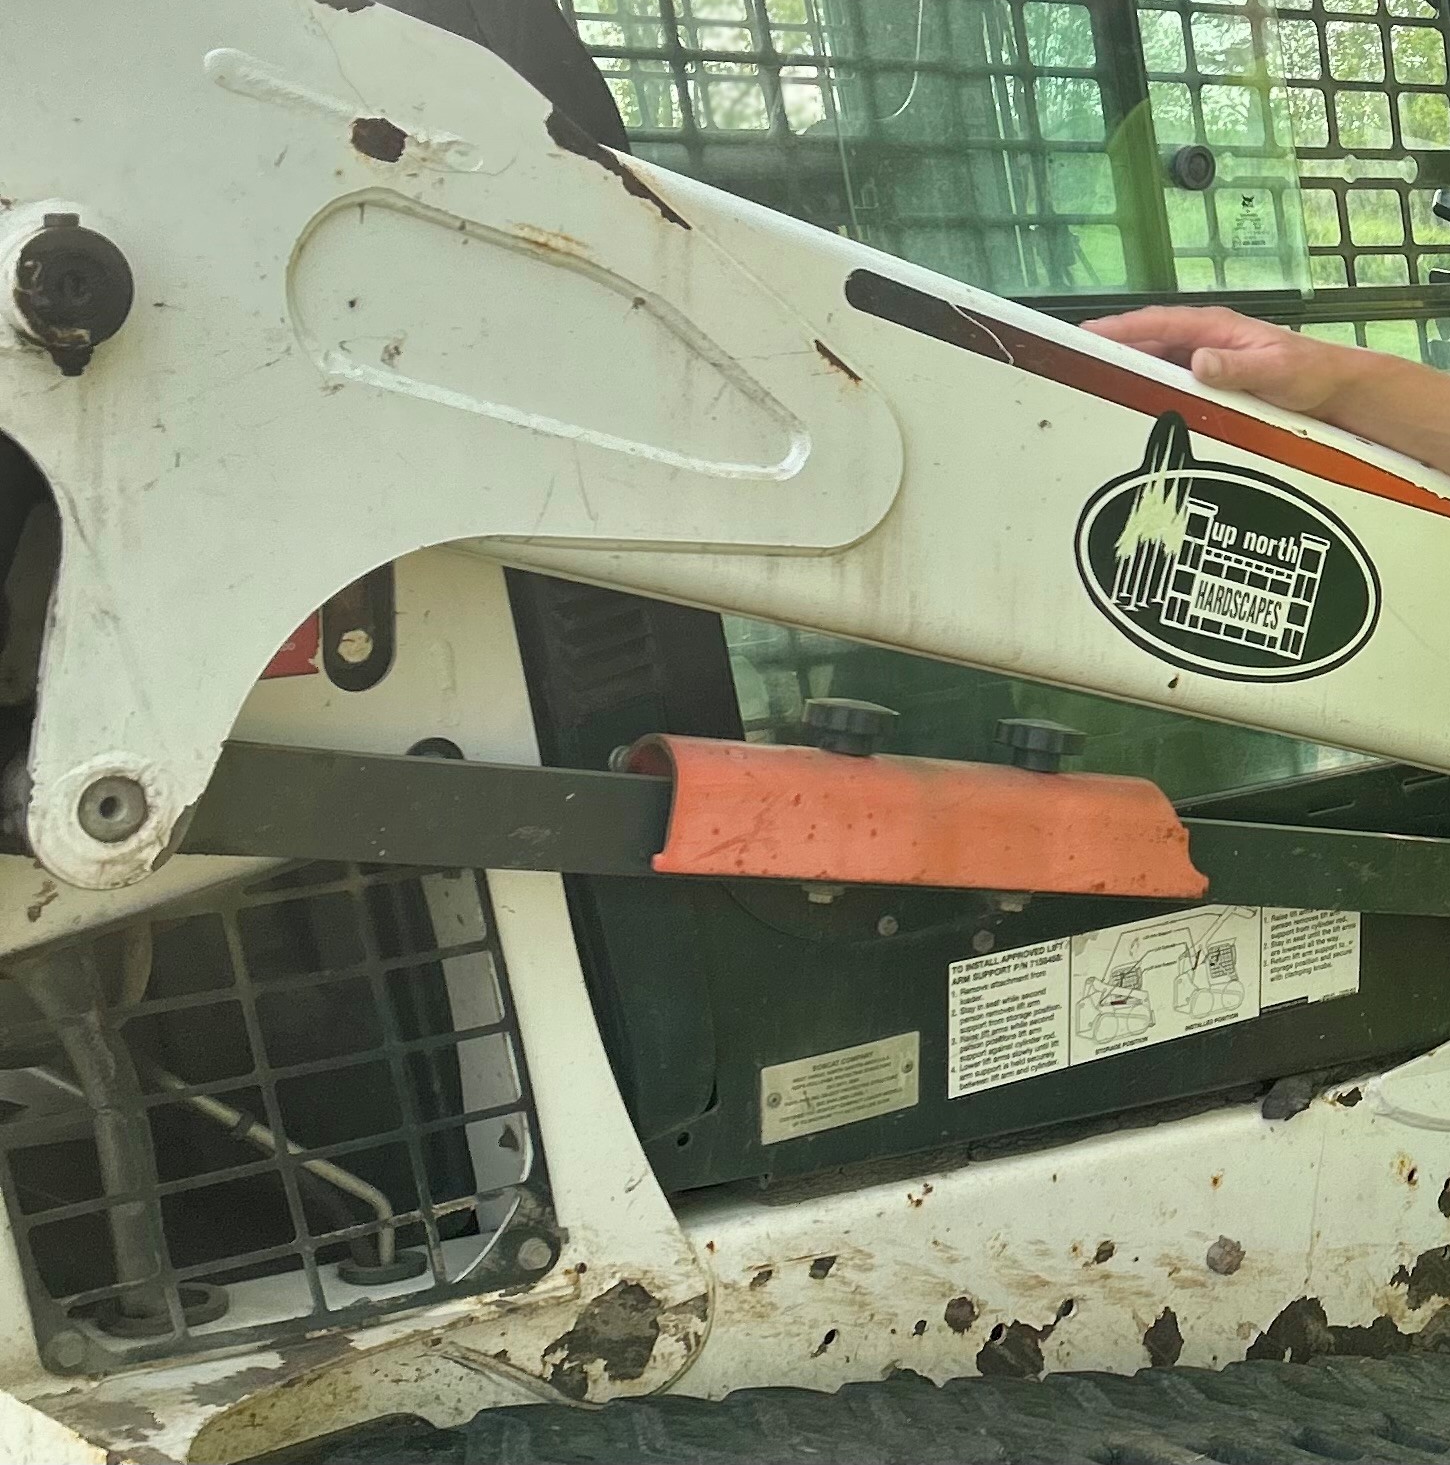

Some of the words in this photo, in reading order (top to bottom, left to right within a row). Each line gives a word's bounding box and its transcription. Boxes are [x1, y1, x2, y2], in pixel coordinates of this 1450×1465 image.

[1211, 521, 1238, 548] up
[1243, 531, 1298, 563] north
[1195, 580, 1282, 630] HARDSCAPES
[1271, 929, 1294, 939] support
[1311, 920, 1334, 930] cylinder
[1293, 934, 1305, 942] seat
[1308, 931, 1320, 939] until
[952, 965, 963, 974] TO
[965, 958, 999, 971] INSTALL
[1001, 947, 1045, 963] APPROVED
[1047, 941, 1063, 953] LIFT
[1271, 956, 1291, 964] Return
[1315, 944, 1337, 954] support
[1282, 943, 1305, 953] lowered
[1270, 964, 1292, 974] storage
[1295, 957, 1318, 968] position
[1320, 953, 1331, 961] and
[1333, 949, 1352, 958] secure
[952, 975, 970, 985] ARM
[973, 965, 1011, 981] SUPPORT
[960, 985, 987, 995] Remove
[990, 974, 1028, 989] attachment
[1031, 971, 1046, 979] from
[1270, 974, 1282, 982] with
[960, 1007, 975, 1015] Stay
[986, 999, 999, 1008] seat
[1002, 995, 1019, 1004] while
[1021, 988, 1046, 1000] second
[960, 1014, 983, 1025] person
[986, 1006, 1014, 1017] removes
[1027, 1000, 1040, 1008] arm
[960, 1021, 986, 1034] support
[988, 1018, 1003, 1026] from
[1006, 1011, 1031, 1022] storage
[960, 1034, 979, 1043] Raise
[991, 1026, 1008, 1036] arms
[1011, 1021, 1027, 1030] while
[1029, 1013, 1054, 1026] second
[1185, 1019, 1212, 1031] INSTALLED
[1214, 1013, 1238, 1023] POSITION
[959, 1042, 983, 1054] person
[985, 1034, 1016, 1047] positions
[1029, 1027, 1041, 1035] arm
[960, 1050, 986, 1062] support
[988, 1043, 1012, 1055] against
[1015, 1036, 1041, 1048] cylinder
[1095, 1043, 1121, 1055] STORAGE
[1122, 1036, 1148, 1047] POSITION
[812, 1060, 839, 1071] BOBCAT
[841, 1051, 873, 1064] COMPANY
[959, 1073, 973, 1081] arm
[975, 1065, 1001, 1077] support
[1010, 1058, 1025, 1067] held
[1027, 1052, 1055, 1063] securely
[960, 1060, 981, 1072] Lower
[993, 1054, 1009, 1063] arms
[1012, 1048, 1032, 1058] slowly
[1035, 1042, 1049, 1052] until
[1051, 1040, 1059, 1048] lift
[959, 1078, 989, 1090] between
[1001, 1071, 1014, 1079] arm
[1016, 1066, 1029, 1075] and
